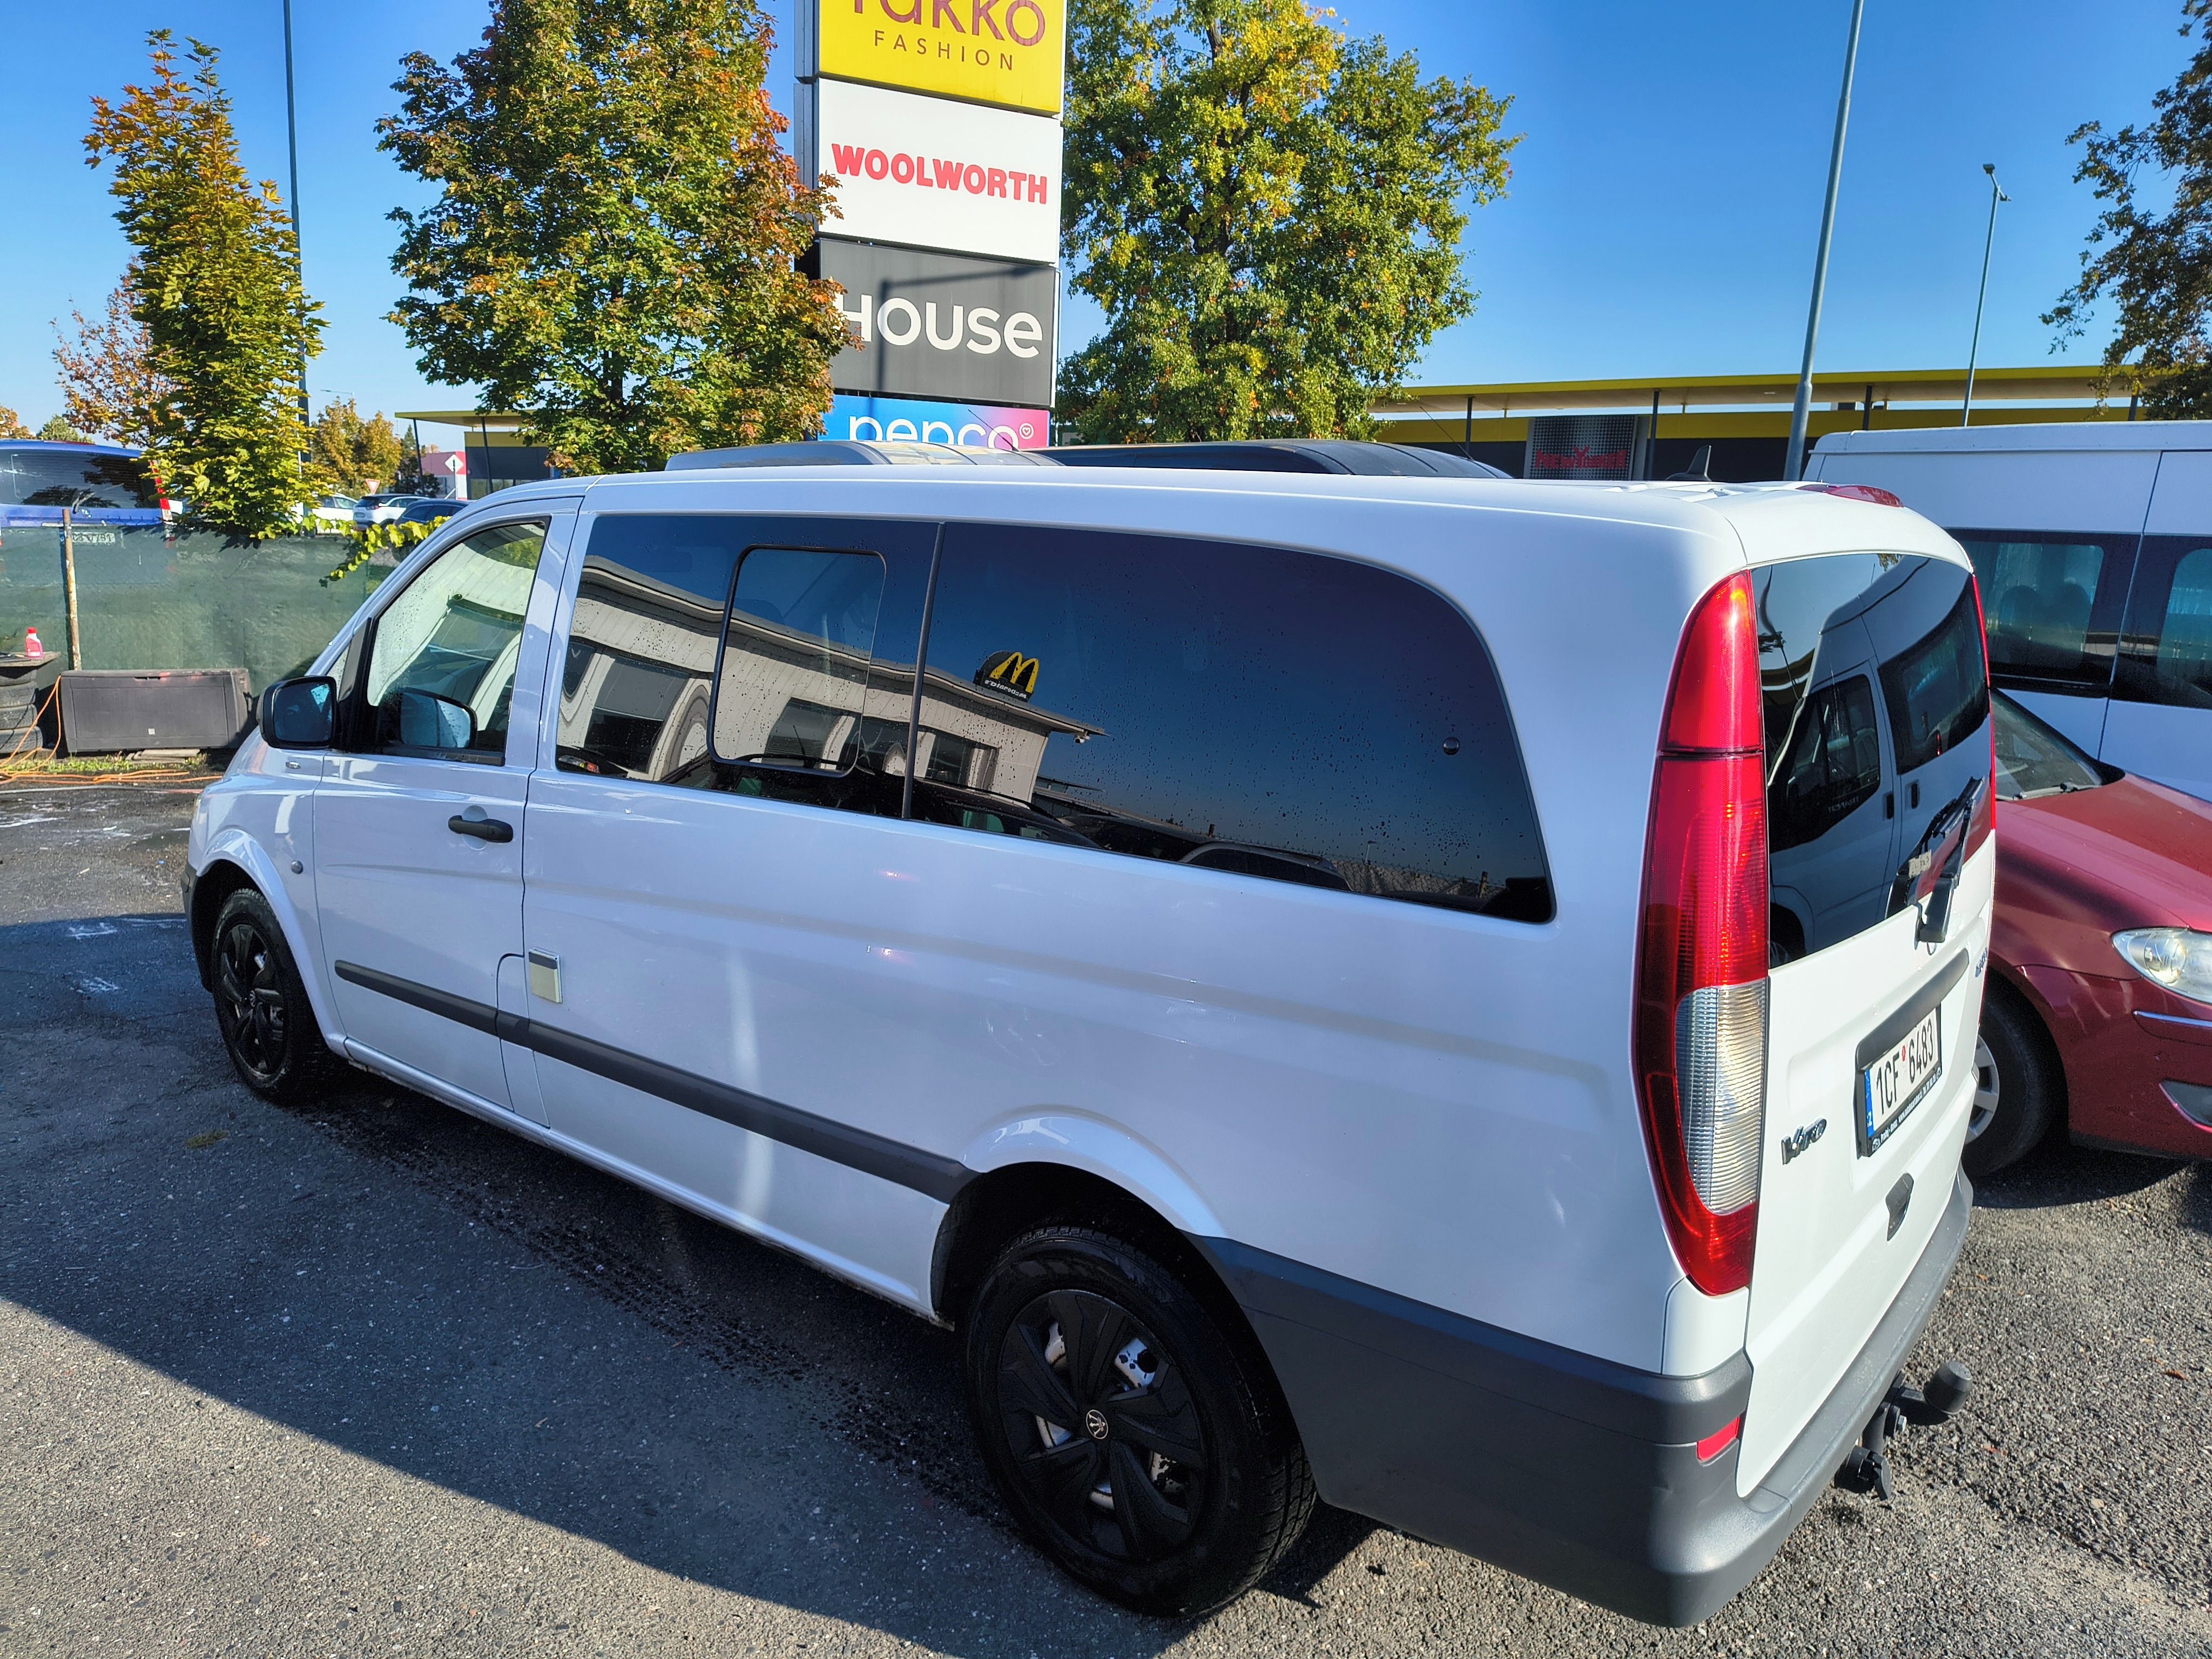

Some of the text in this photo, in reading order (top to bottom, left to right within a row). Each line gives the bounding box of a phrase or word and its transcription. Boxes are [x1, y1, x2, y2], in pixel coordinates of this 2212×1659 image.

[854, 0, 1046, 46] akko
[874, 30, 1013, 71] FASHION
[831, 143, 1047, 205] WOOLWORTH
[1876, 1051, 1899, 1115] 1CF
[1908, 1018, 1933, 1083] 6483
